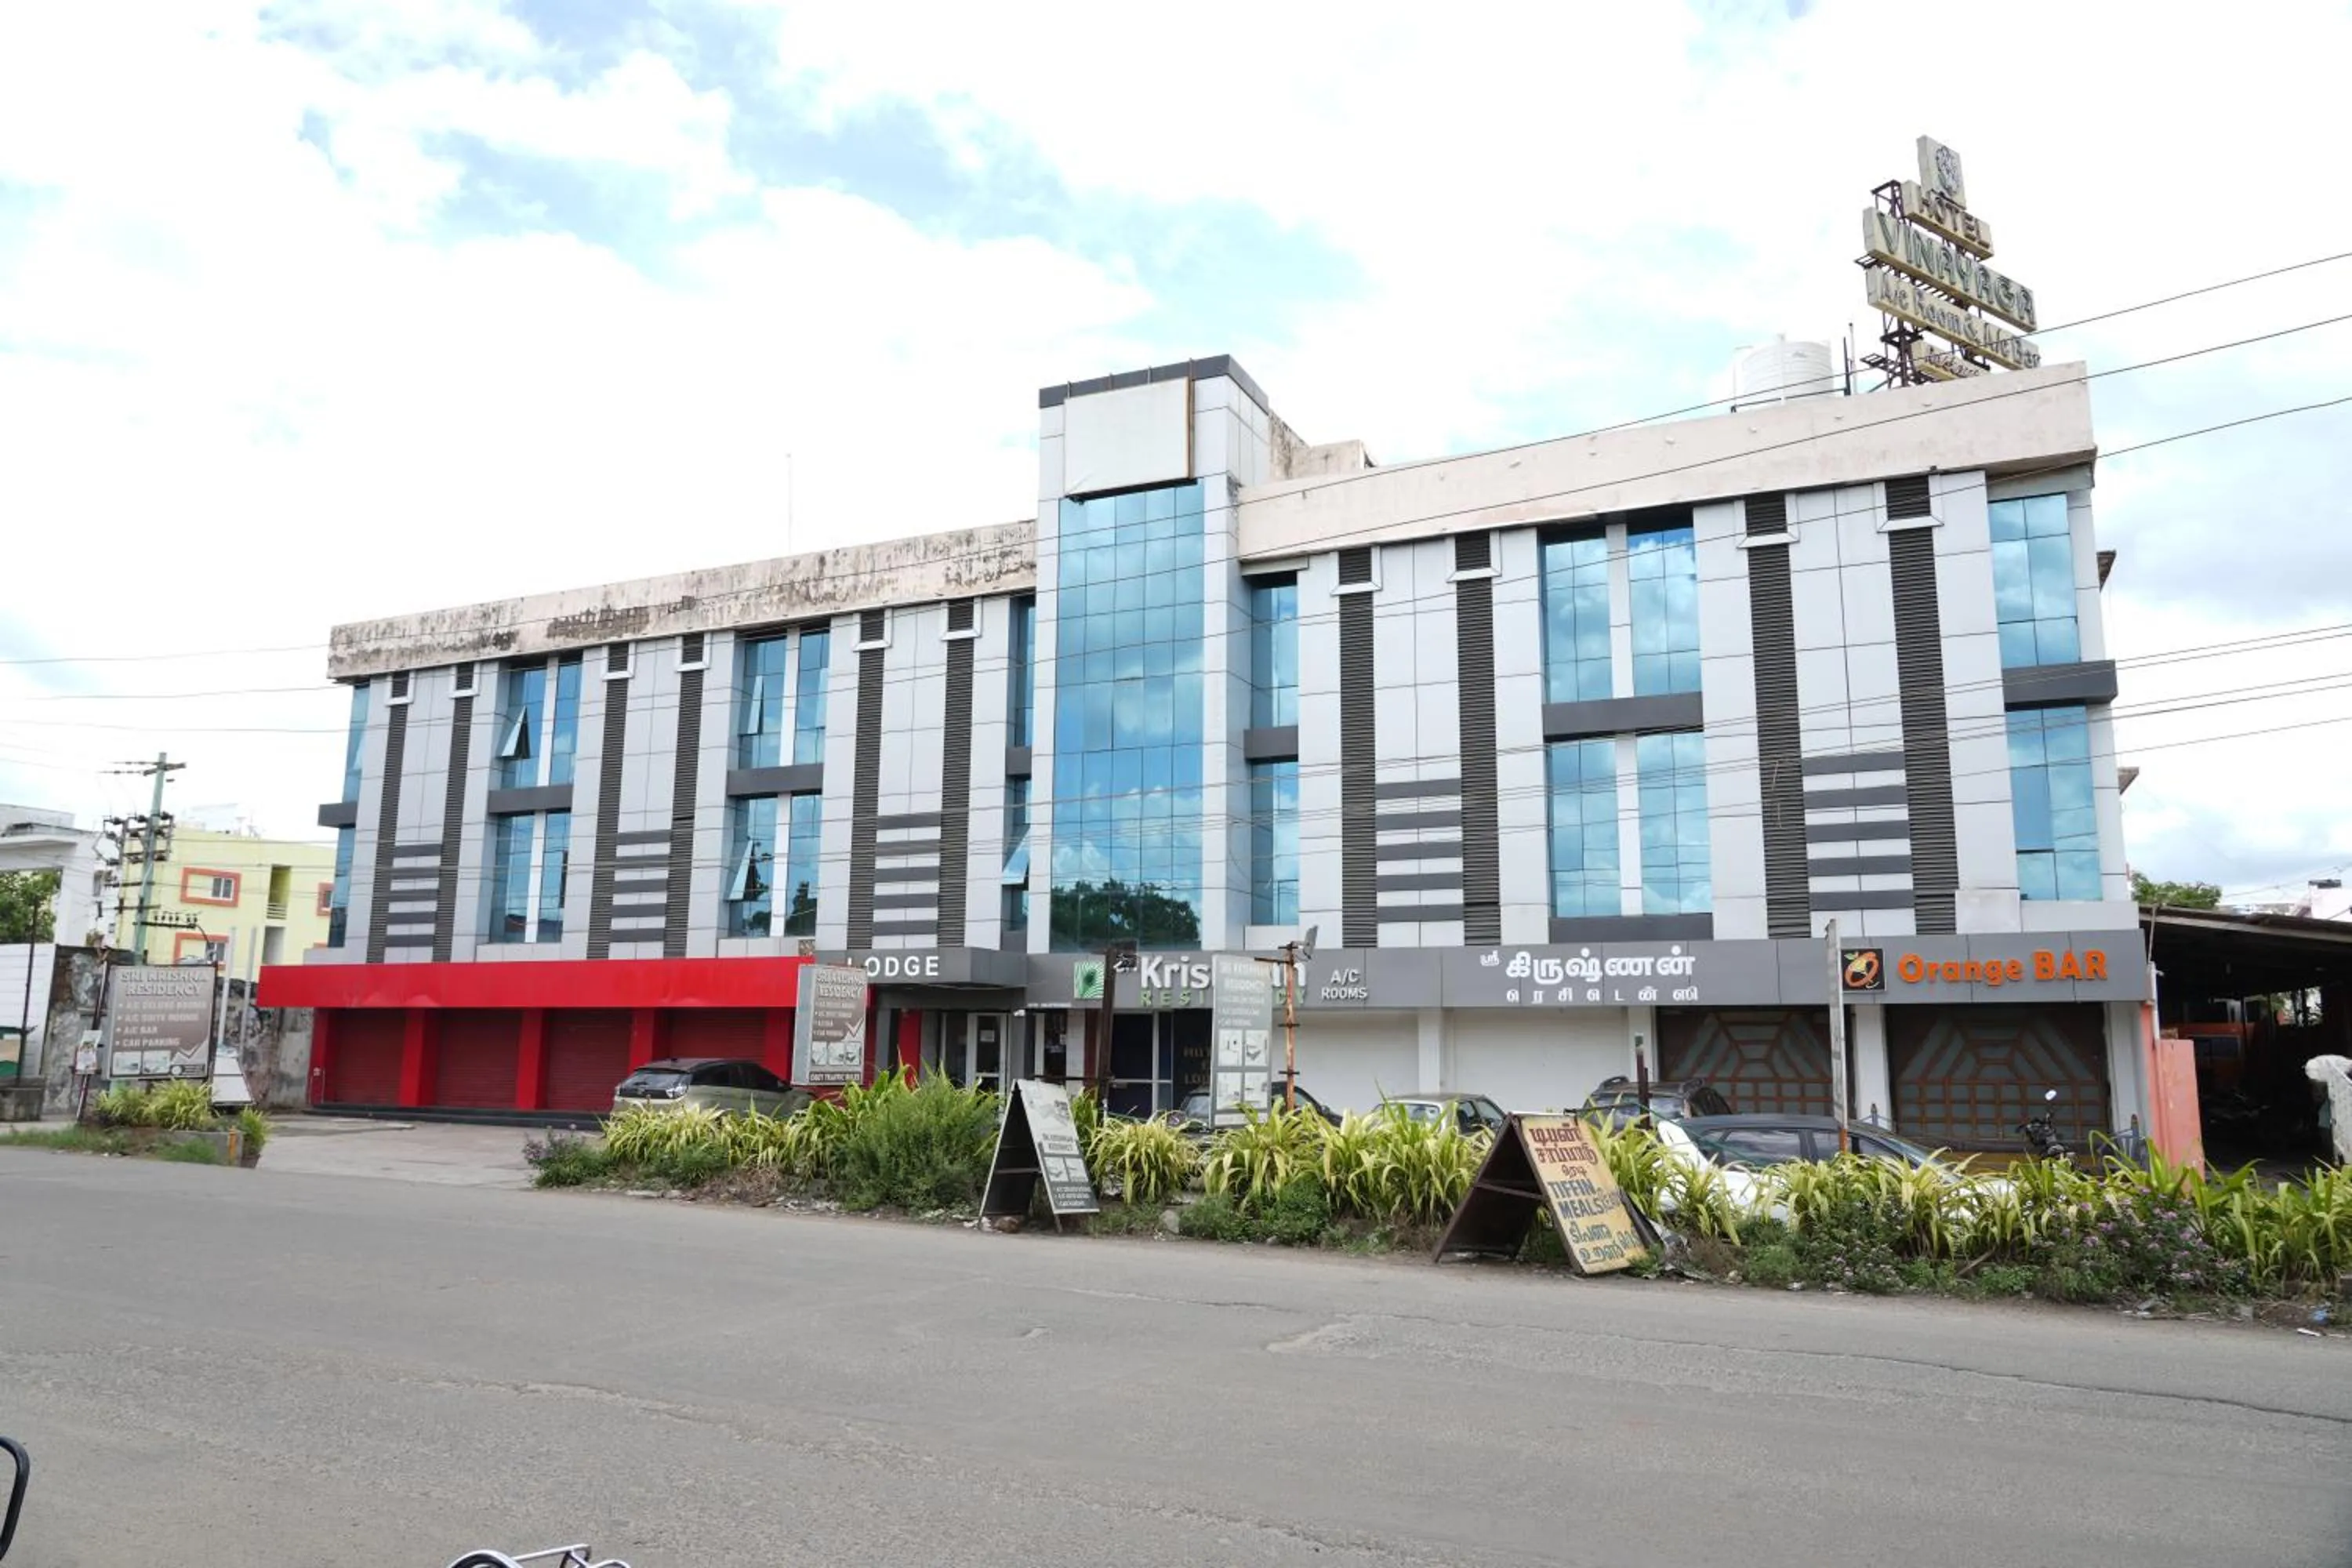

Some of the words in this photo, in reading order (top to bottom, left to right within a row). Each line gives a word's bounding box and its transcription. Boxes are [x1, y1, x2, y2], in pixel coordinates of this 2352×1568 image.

[1920, 191, 1991, 249] HOTEL
[1877, 210, 2036, 326] VINAYAGA
[1140, 955, 1307, 989] Krisn
[1330, 968, 1359, 984] A/C
[1505, 945, 1697, 985] கிருஷ்ணன்
[1897, 953, 2023, 986] Orange
[2032, 949, 2109, 982] BAR
[1320, 985, 1369, 1000] ROOMS
[1548, 1178, 1597, 1199] TIFFIN
[1558, 1196, 1604, 1219] MEALS
